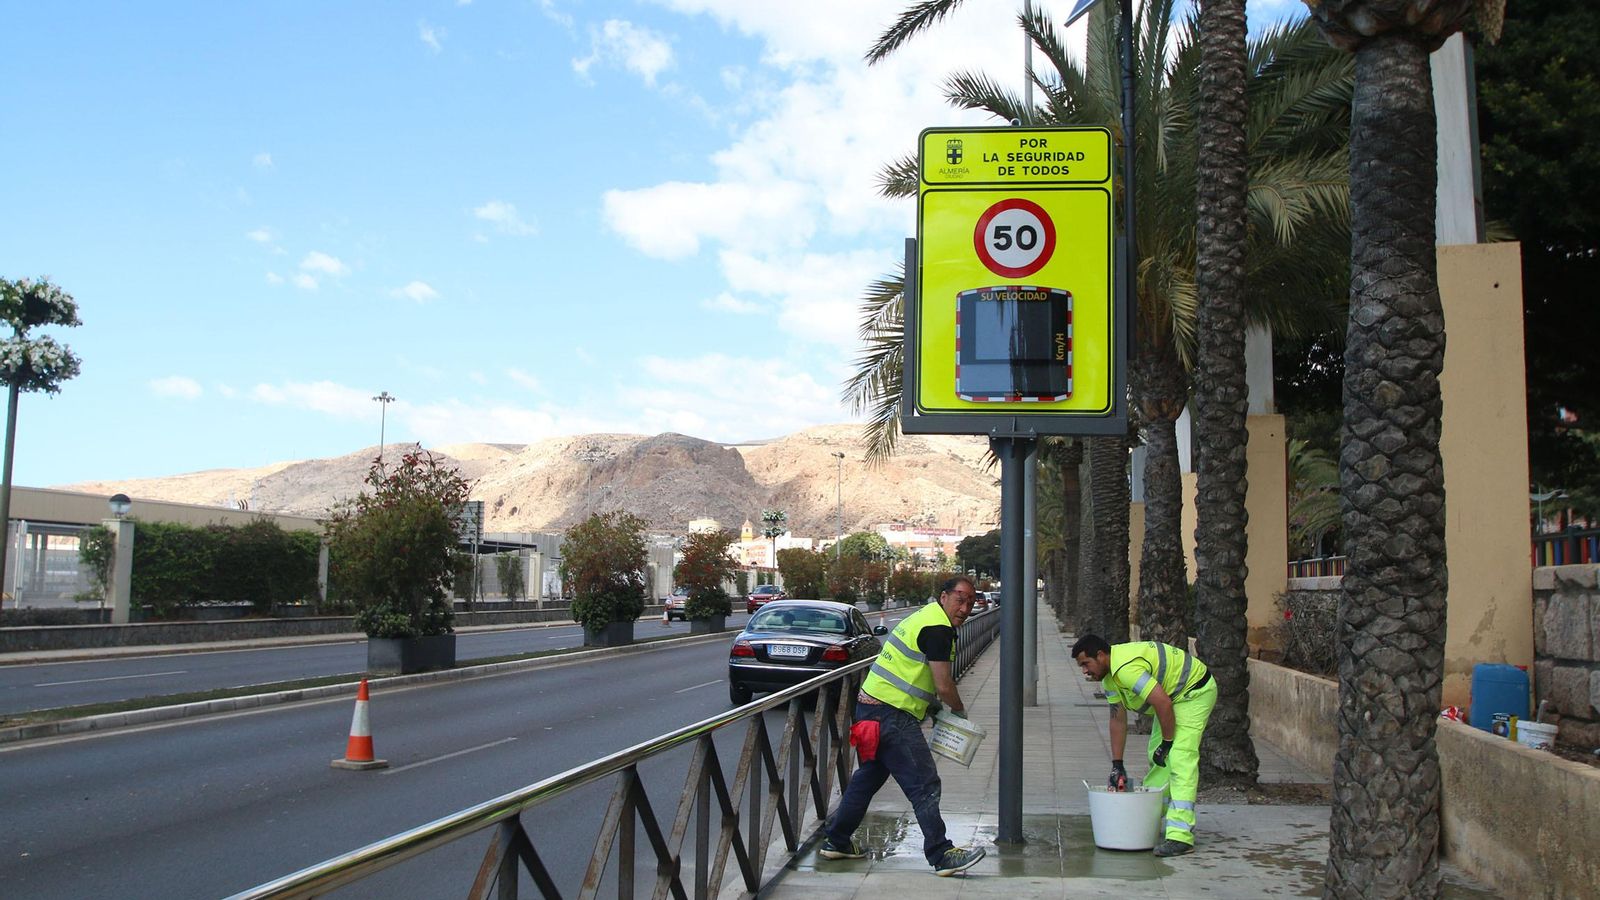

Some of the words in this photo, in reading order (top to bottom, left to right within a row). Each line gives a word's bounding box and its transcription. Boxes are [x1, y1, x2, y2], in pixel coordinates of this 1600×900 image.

[1020, 139, 1047, 148] POR
[983, 153, 999, 162] LA
[1007, 152, 1085, 162] SEGURIDAD
[998, 166, 1015, 176] DE
[1022, 165, 1070, 176] TODOS
[993, 225, 1038, 251] 50
[981, 292, 993, 301] SU
[995, 292, 1047, 301] VELOCIDAD
[1056, 333, 1066, 360] Km/H
